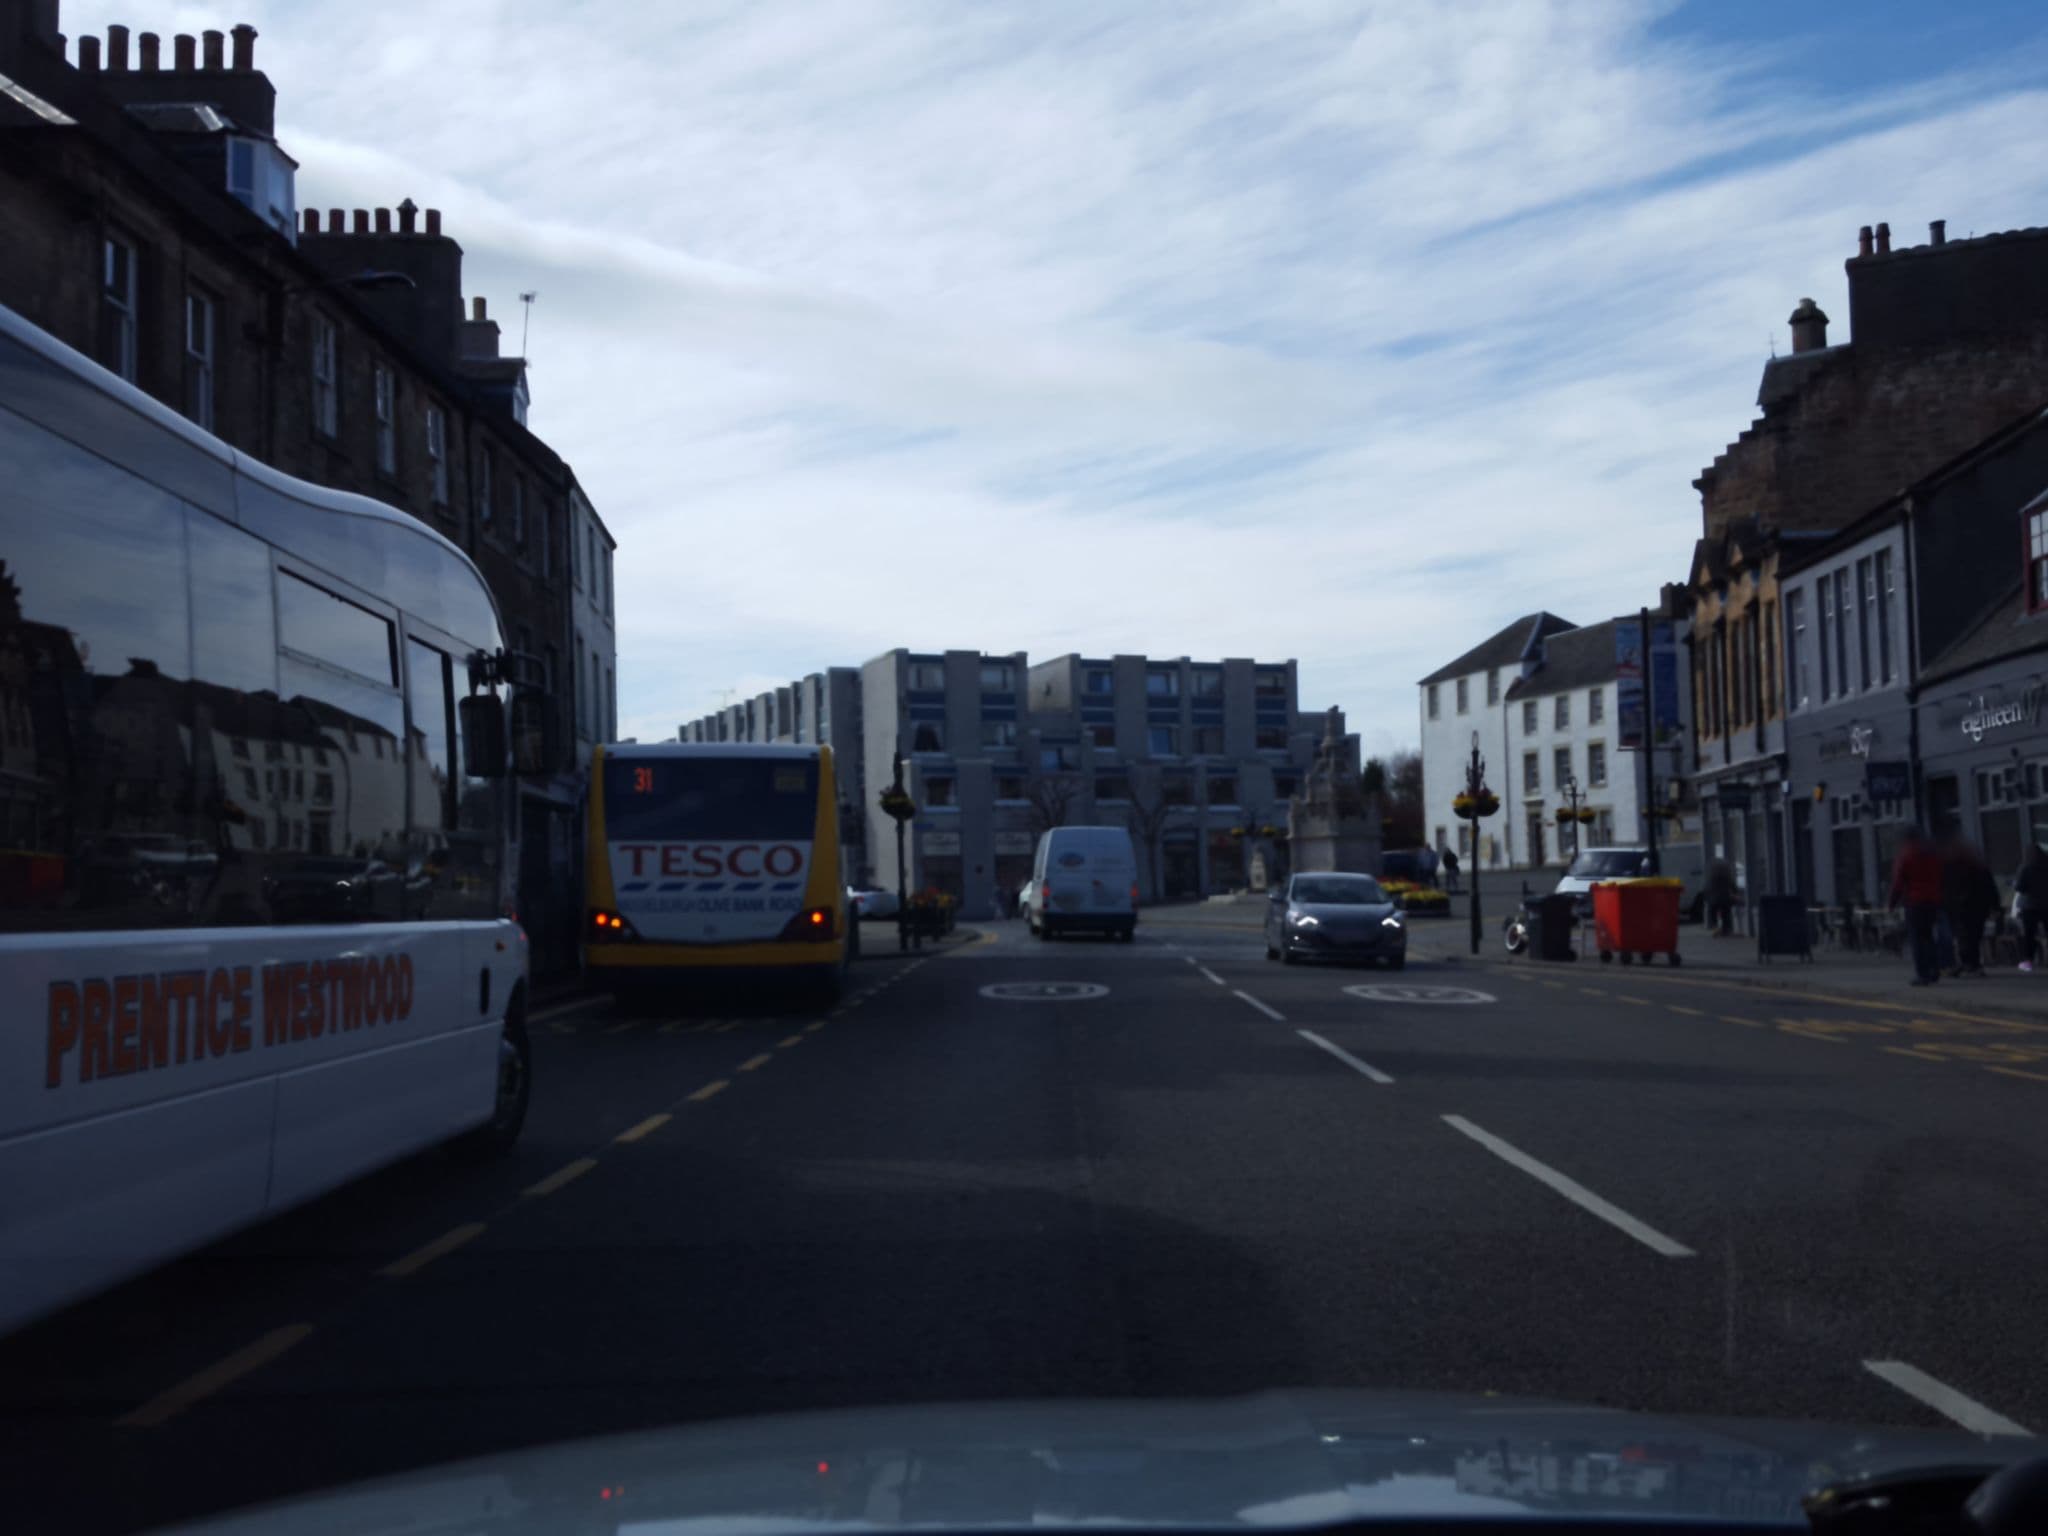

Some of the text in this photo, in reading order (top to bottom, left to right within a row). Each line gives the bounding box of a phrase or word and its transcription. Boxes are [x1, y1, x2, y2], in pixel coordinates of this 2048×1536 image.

[634, 766, 654, 795] 31
[619, 844, 803, 878] TESCO
[46, 952, 414, 1089] PRENTICE WESTWOOD
